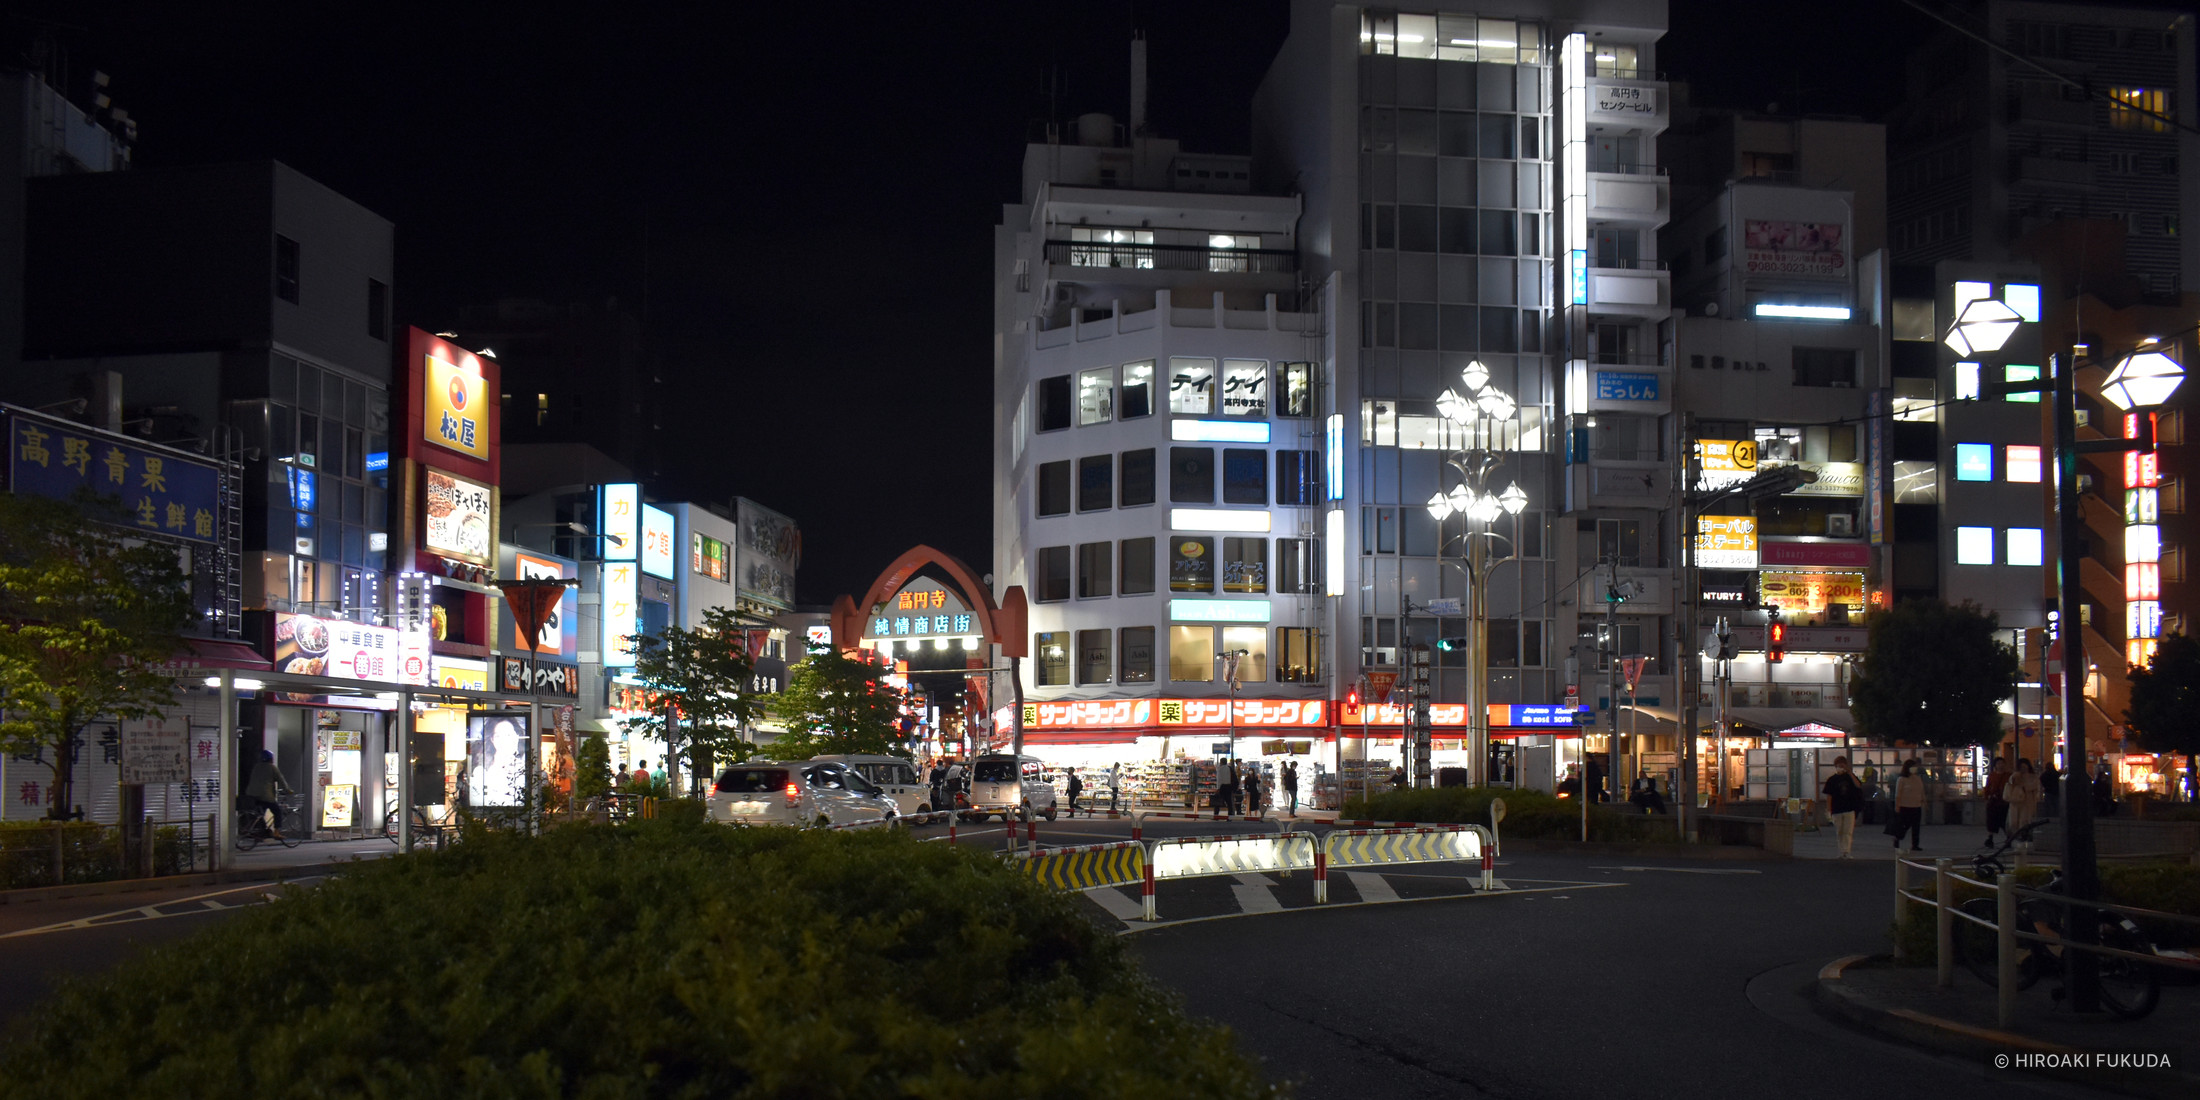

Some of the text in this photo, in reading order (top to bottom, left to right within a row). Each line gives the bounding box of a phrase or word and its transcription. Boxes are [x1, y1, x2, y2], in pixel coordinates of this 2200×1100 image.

[1610, 87, 1640, 99] 高円寺
[1599, 100, 1652, 113] センタービル
[1599, 384, 1656, 399] にっしん
[1224, 398, 1266, 408] 高円寺支社
[439, 410, 476, 449] 松屋
[1739, 446, 1754, 461] 21
[136, 495, 214, 538] 生鮮館
[612, 498, 631, 652] カラオケ館
[898, 589, 946, 611] 高円寺
[1205, 604, 1235, 619] Ash
[874, 614, 972, 636] 純情商店街
[339, 630, 384, 649] 中華食堂
[339, 651, 384, 678] 一番館
[1048, 655, 1063, 663] Ash
[1089, 653, 1105, 662] Ash
[1373, 675, 1393, 684] 止まれ
[1023, 701, 1132, 725] 薬 サンドラッグ
[1161, 700, 1301, 724] 薬 サンドラッグ
